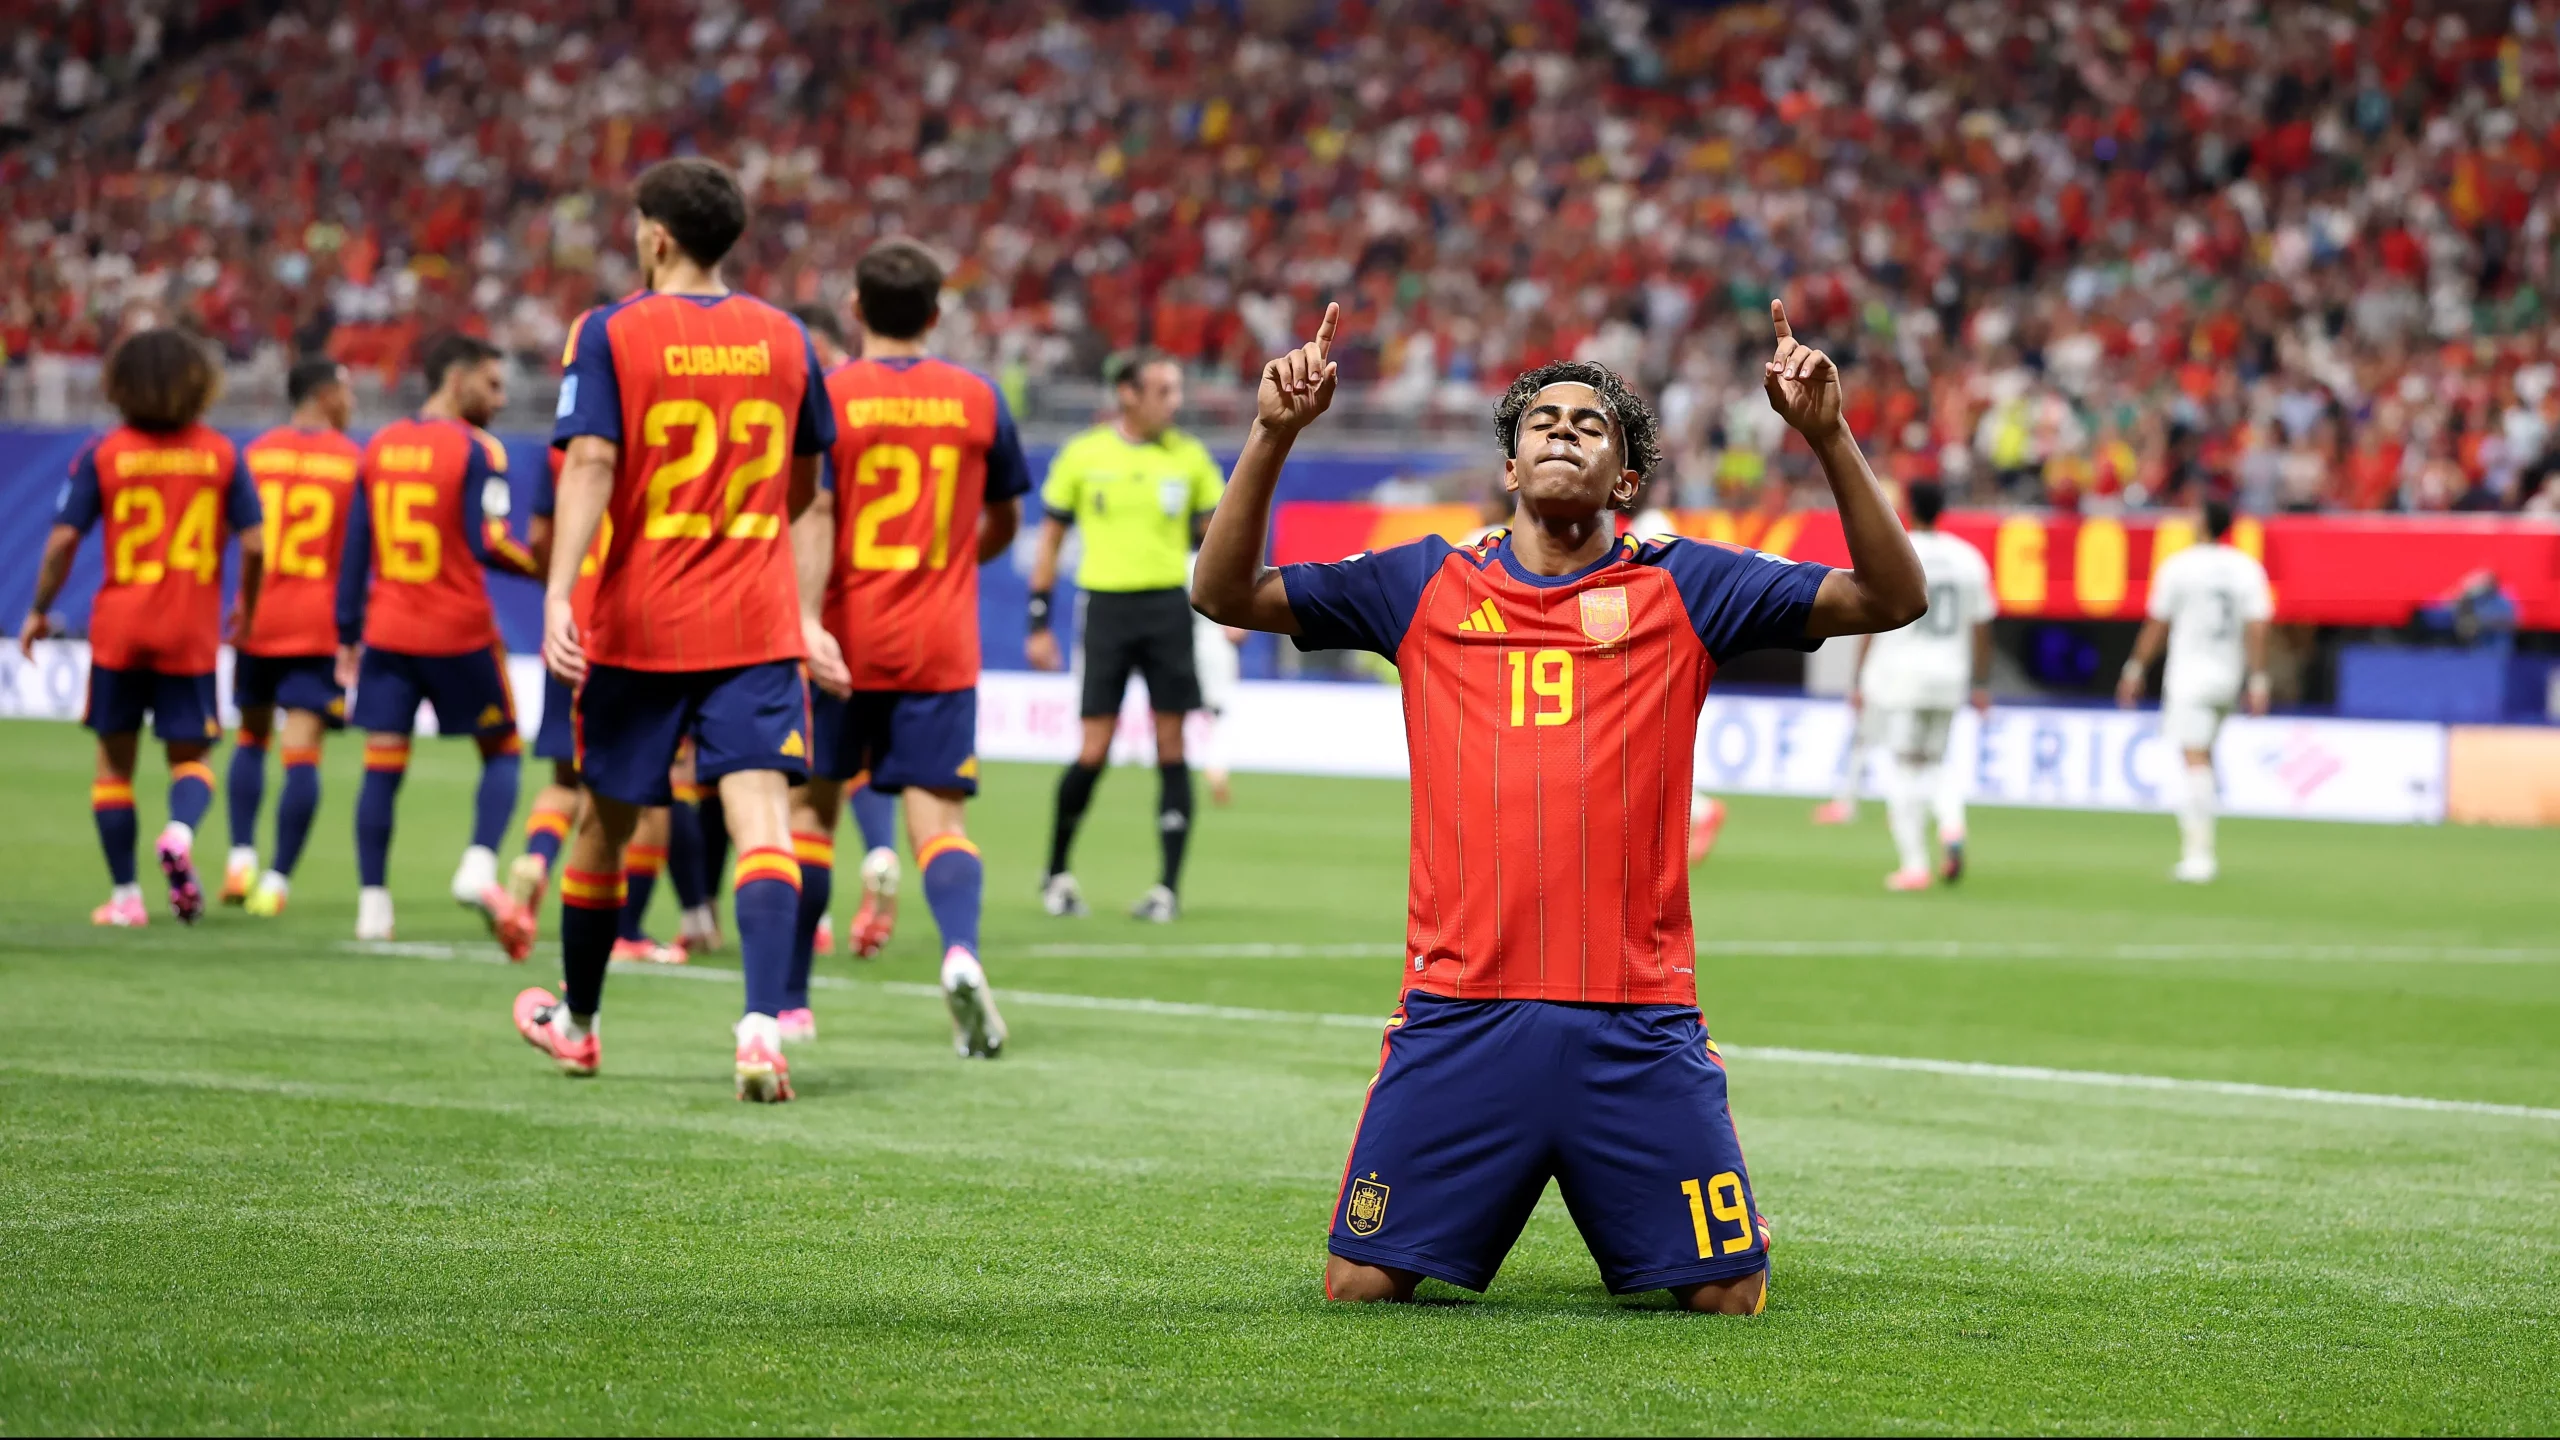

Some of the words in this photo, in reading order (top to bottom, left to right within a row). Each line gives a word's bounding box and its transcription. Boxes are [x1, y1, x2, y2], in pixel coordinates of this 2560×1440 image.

[663, 339, 770, 376] CUBARSÍ
[645, 399, 786, 541] 22
[852, 444, 960, 571] 21
[113, 486, 217, 584] 24
[258, 479, 334, 579] 12
[373, 480, 440, 583] 15
[1508, 648, 1574, 727] 19
[1681, 1171, 1753, 1258] 19
